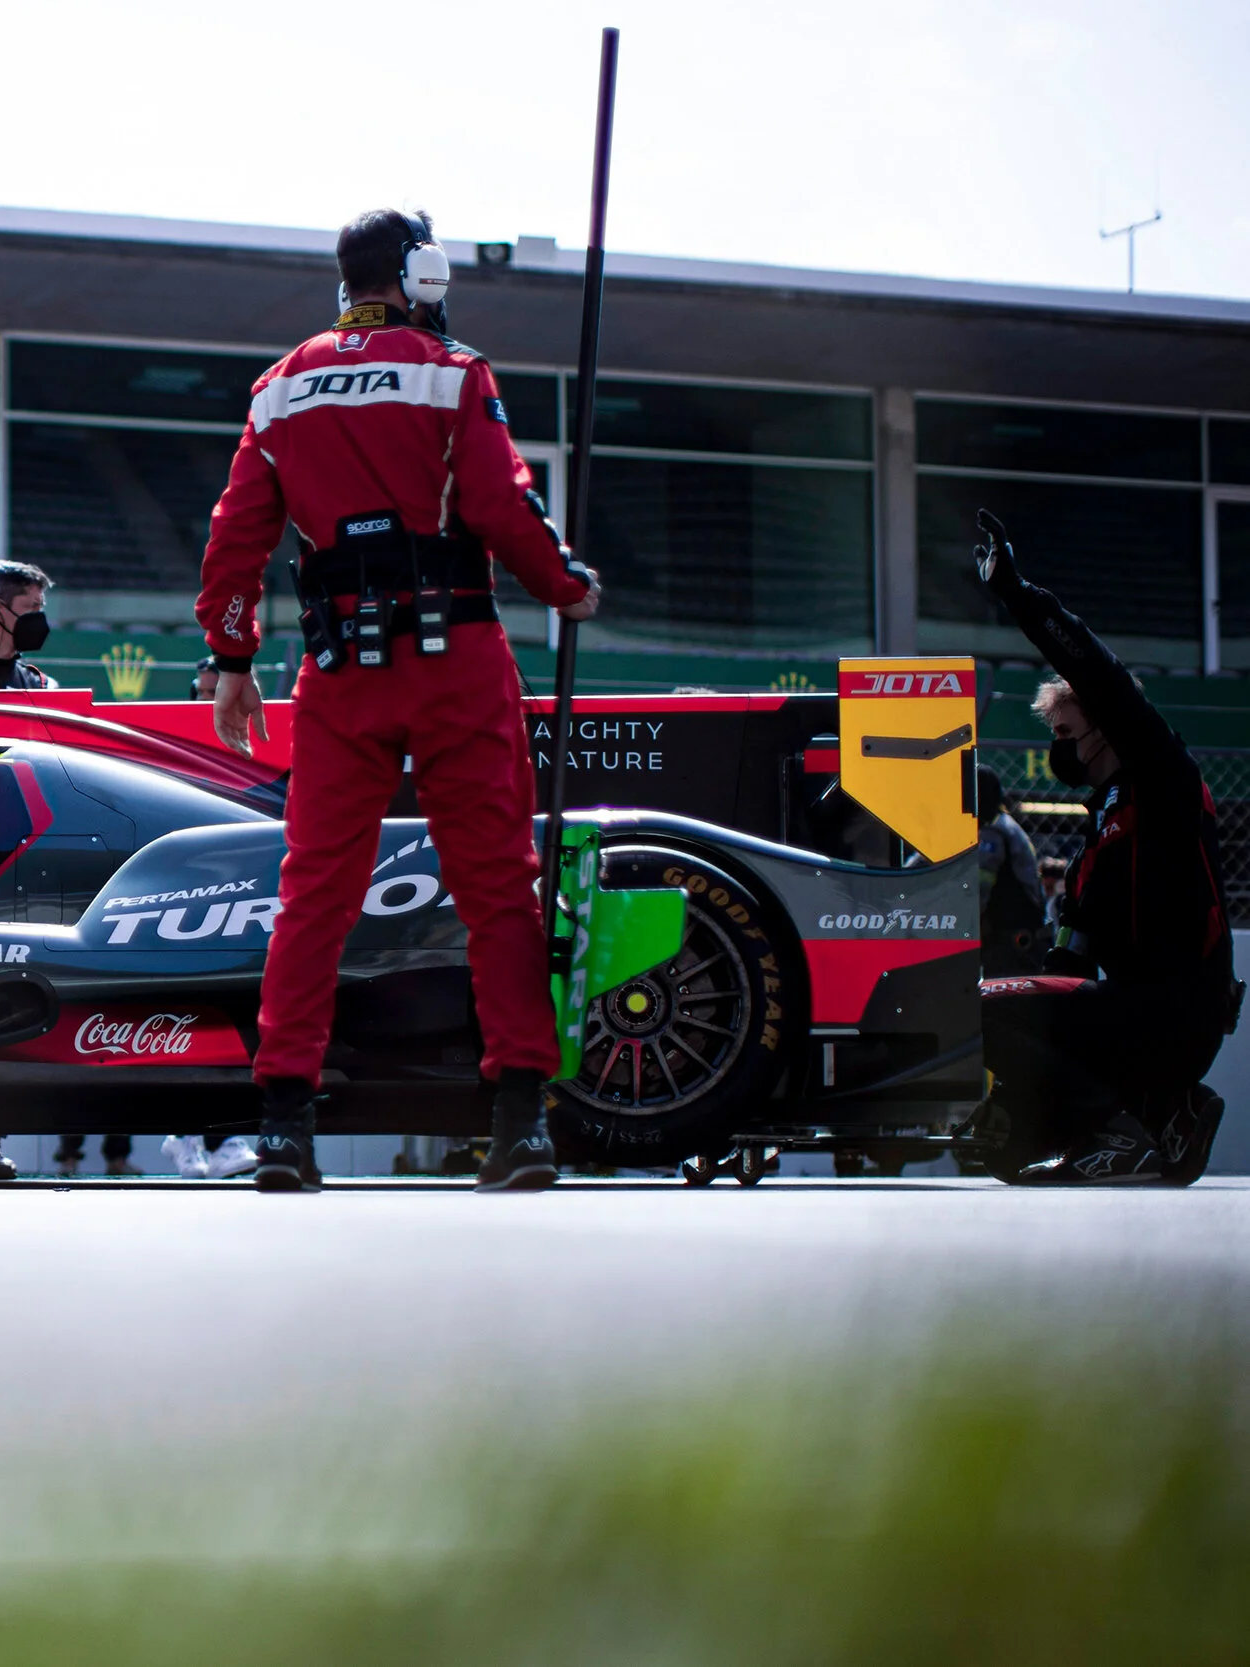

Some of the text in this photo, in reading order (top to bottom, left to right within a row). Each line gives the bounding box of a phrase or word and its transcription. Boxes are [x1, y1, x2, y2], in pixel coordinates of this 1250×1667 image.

[289, 370, 400, 403] JOTA
[347, 518, 391, 535] sparco
[850, 673, 962, 694] JOTA
[534, 721, 664, 740] AGHTY
[538, 751, 664, 770] NATURE
[104, 879, 258, 910] PERTAMAX
[102, 873, 440, 945] TURO
[567, 850, 595, 1048] START
